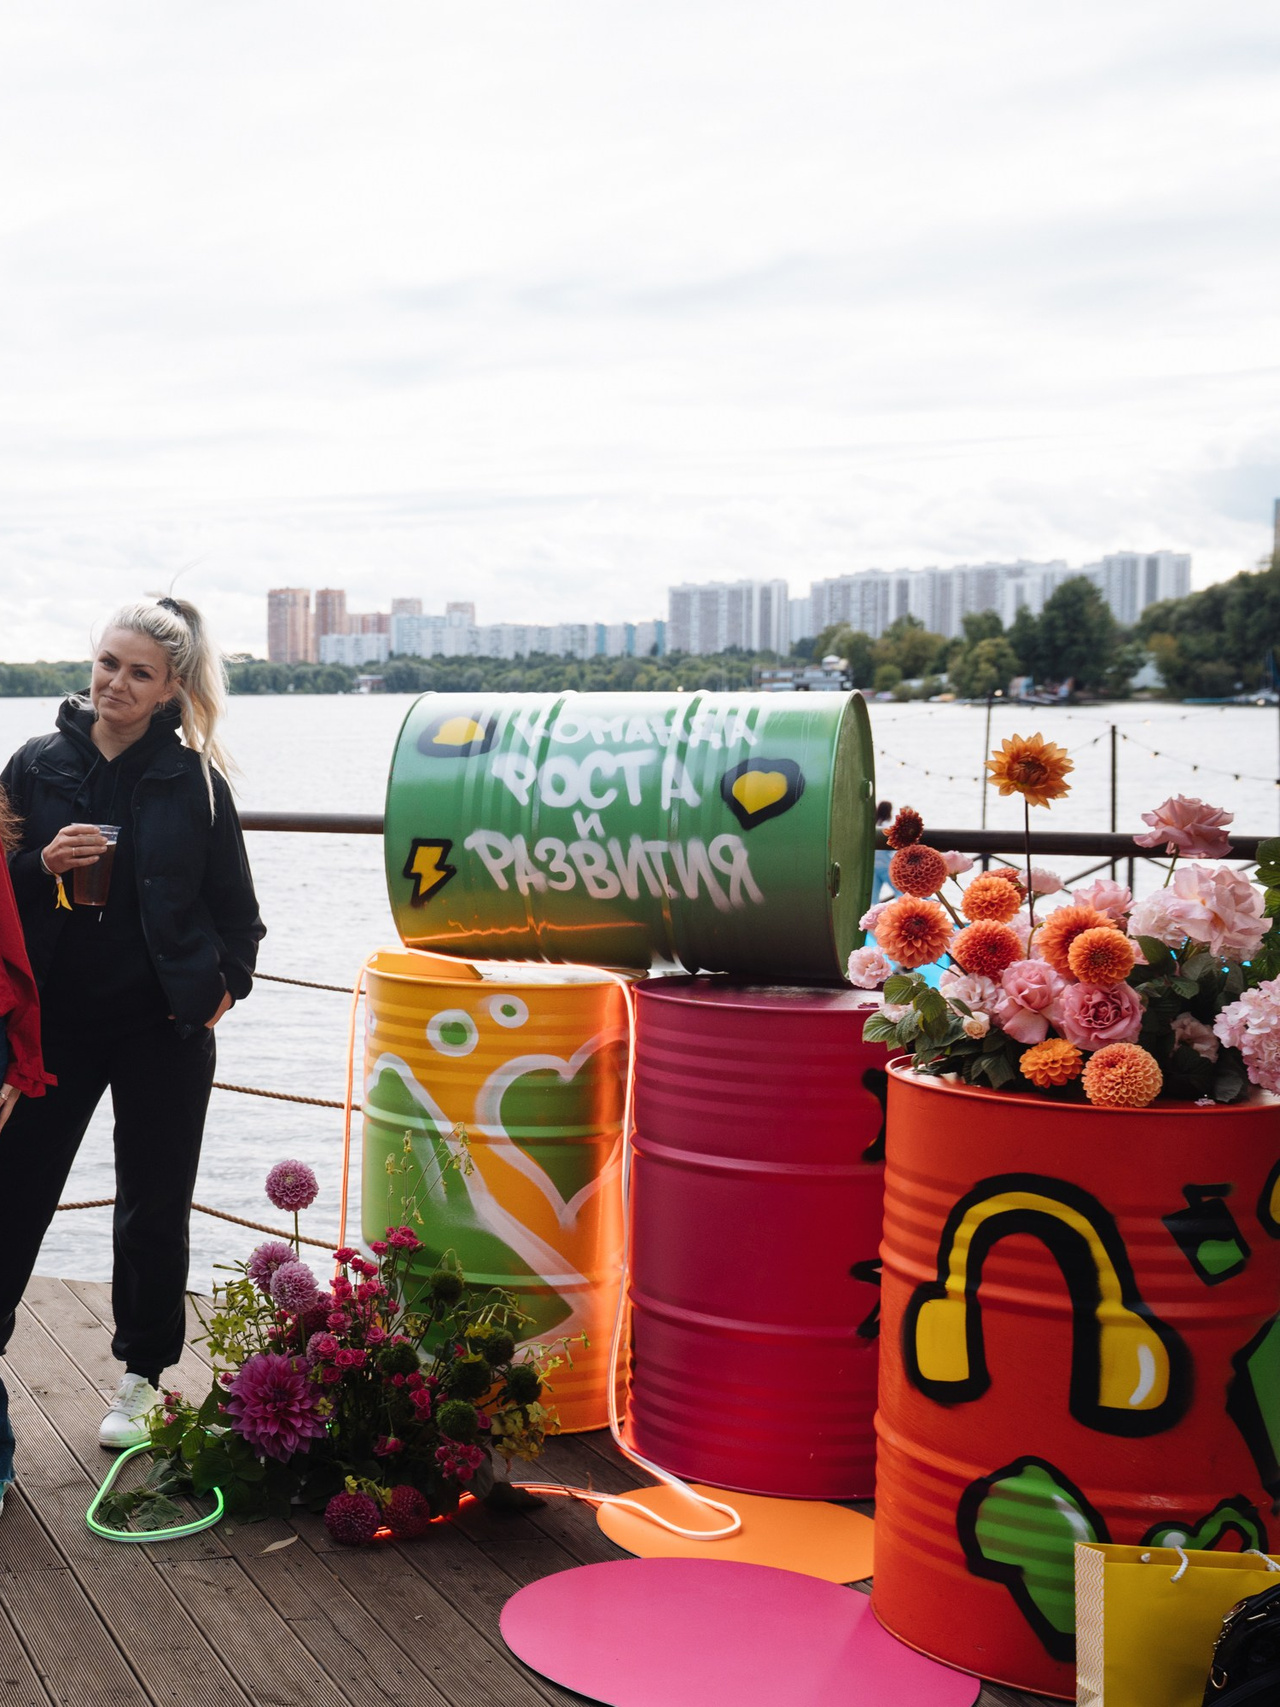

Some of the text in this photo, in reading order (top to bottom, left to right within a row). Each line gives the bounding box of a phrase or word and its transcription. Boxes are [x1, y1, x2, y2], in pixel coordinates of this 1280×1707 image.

[513, 714, 758, 749] КОМАНДА
[491, 750, 702, 810] РОСТА
[463, 829, 766, 910] РАЗВИТИЯ
